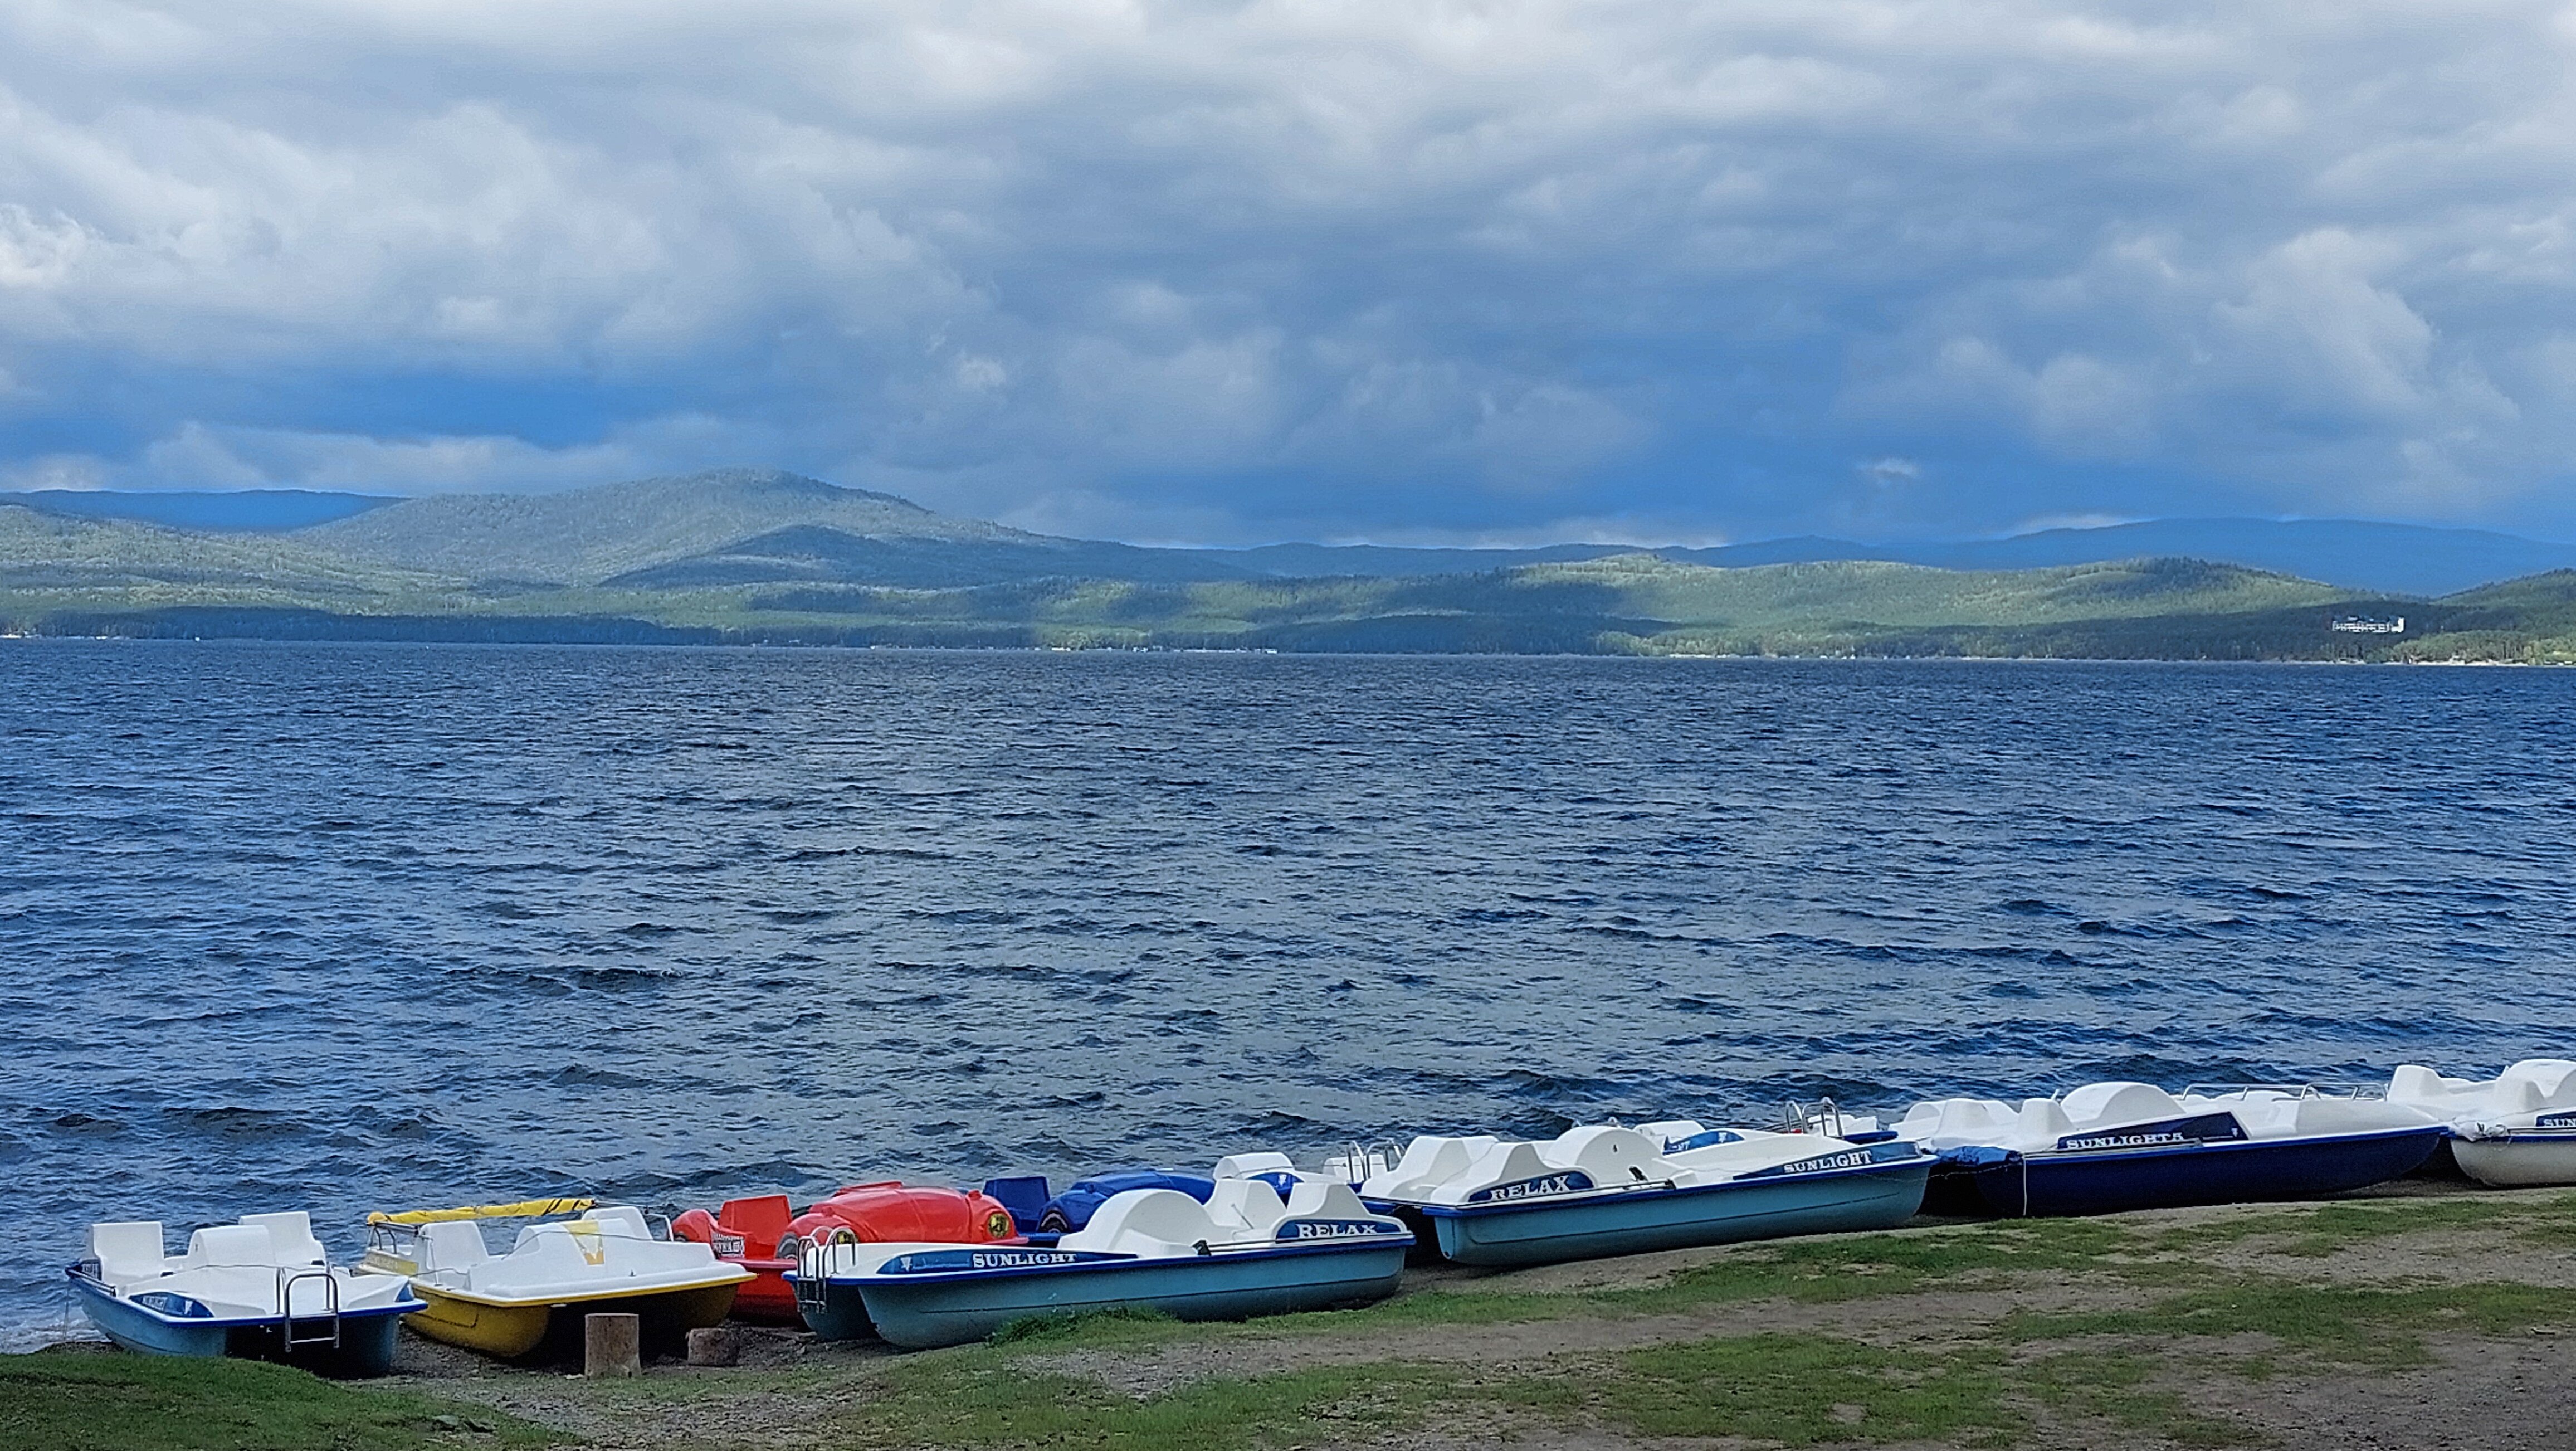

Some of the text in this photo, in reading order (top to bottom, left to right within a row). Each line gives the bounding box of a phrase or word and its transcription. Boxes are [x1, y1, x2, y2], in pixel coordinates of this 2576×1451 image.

[2066, 1133, 2171, 1149] SUNLIGHT
[1784, 1150, 1872, 1173] SUNLIGHT
[1490, 1175, 1570, 1201] RELAX
[1295, 1223, 1377, 1238] RELAX
[973, 1253, 1076, 1268] SUNLIGHT
